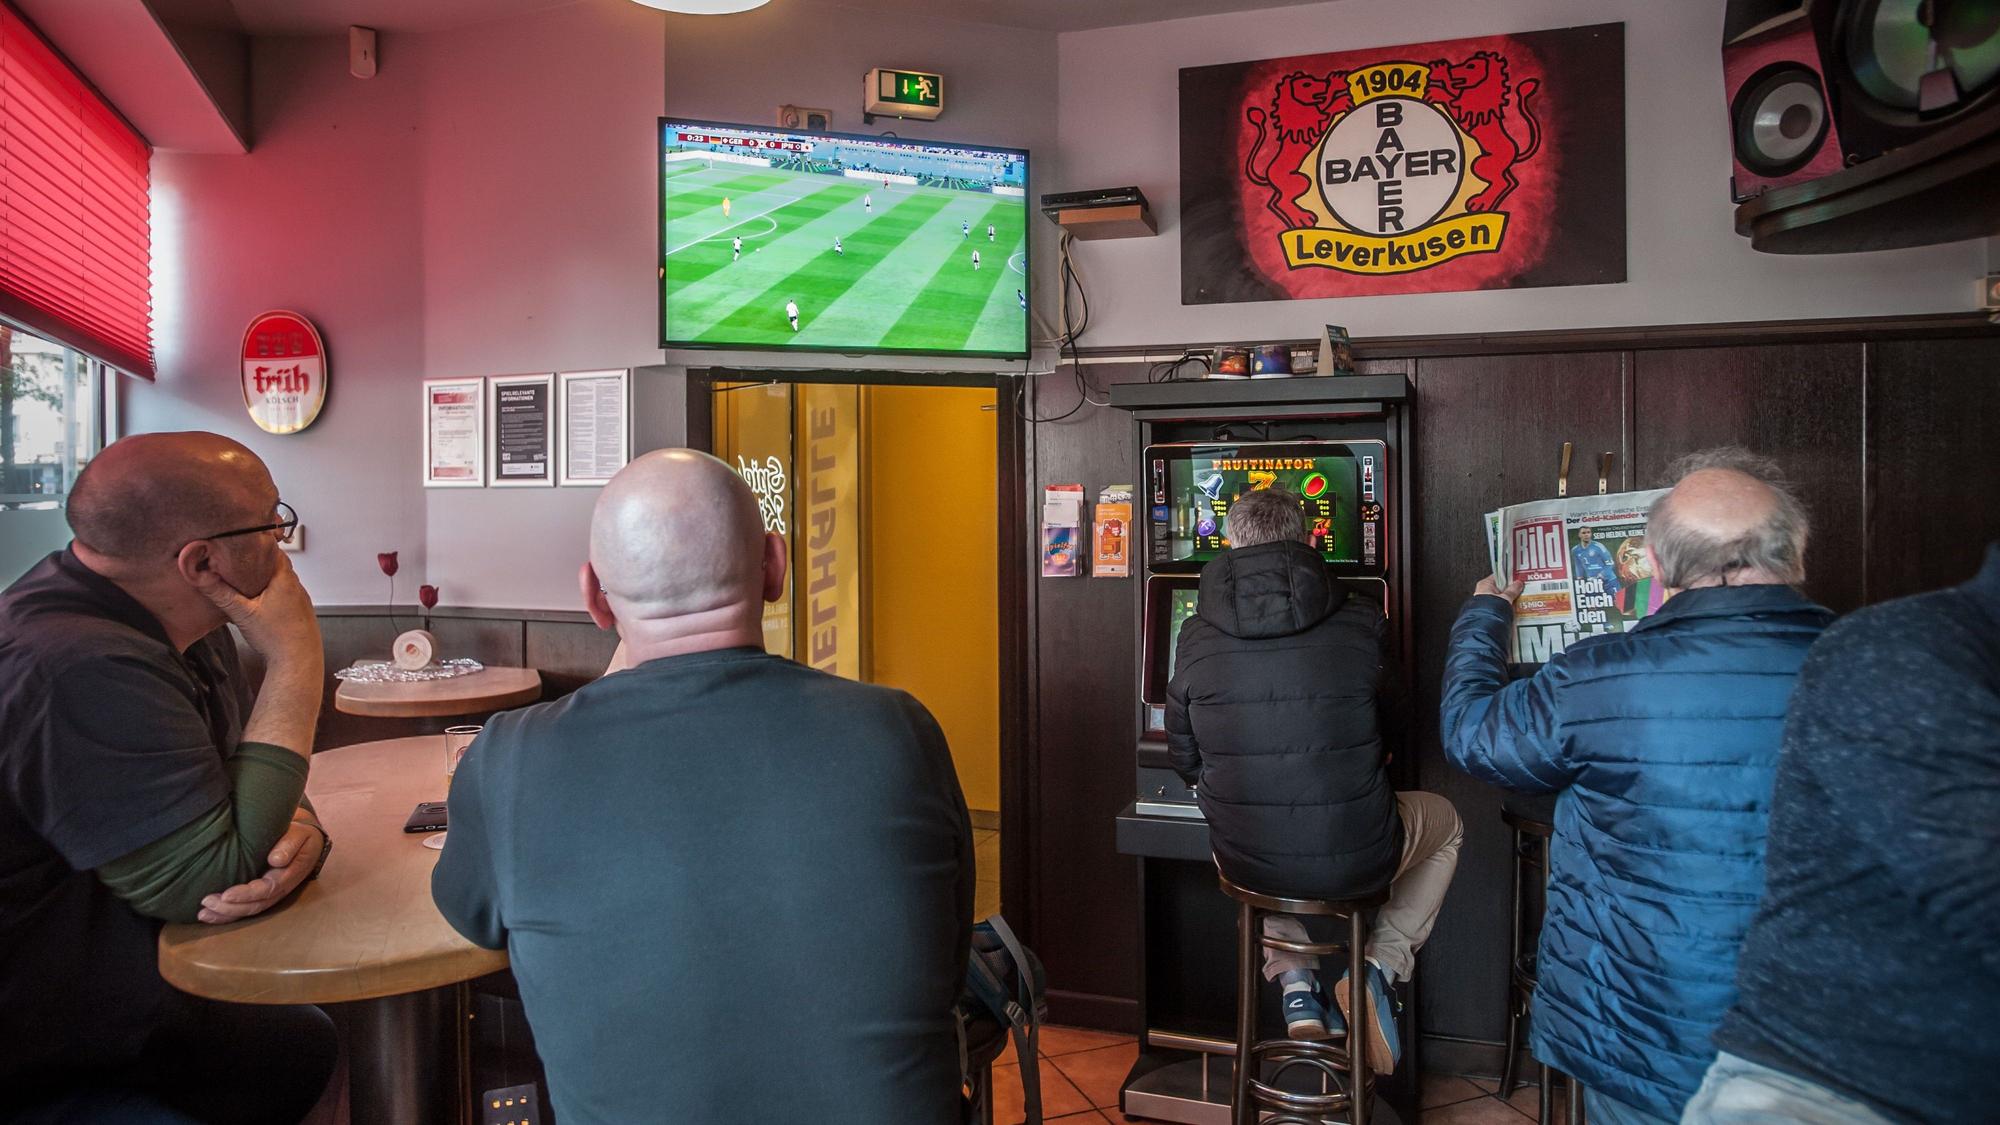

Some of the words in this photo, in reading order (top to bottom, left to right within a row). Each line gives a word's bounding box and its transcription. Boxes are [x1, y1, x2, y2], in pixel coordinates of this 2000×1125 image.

[1355, 68, 1422, 97] 1904
[781, 142, 793, 150] JPN
[1325, 149, 1456, 184] BAYER
[1375, 102, 1405, 232] BAYER
[1296, 223, 1490, 267] Leverkusen
[1212, 458, 1314, 470] FRUITINATOR
[1581, 513, 1639, 523] Geld-Kalender
[1516, 524, 1563, 571] Bild
[1527, 572, 1552, 580] KÖLN
[1575, 578, 1605, 594] Holt
[1577, 592, 1613, 608] Euch
[1579, 609, 1607, 623] den
